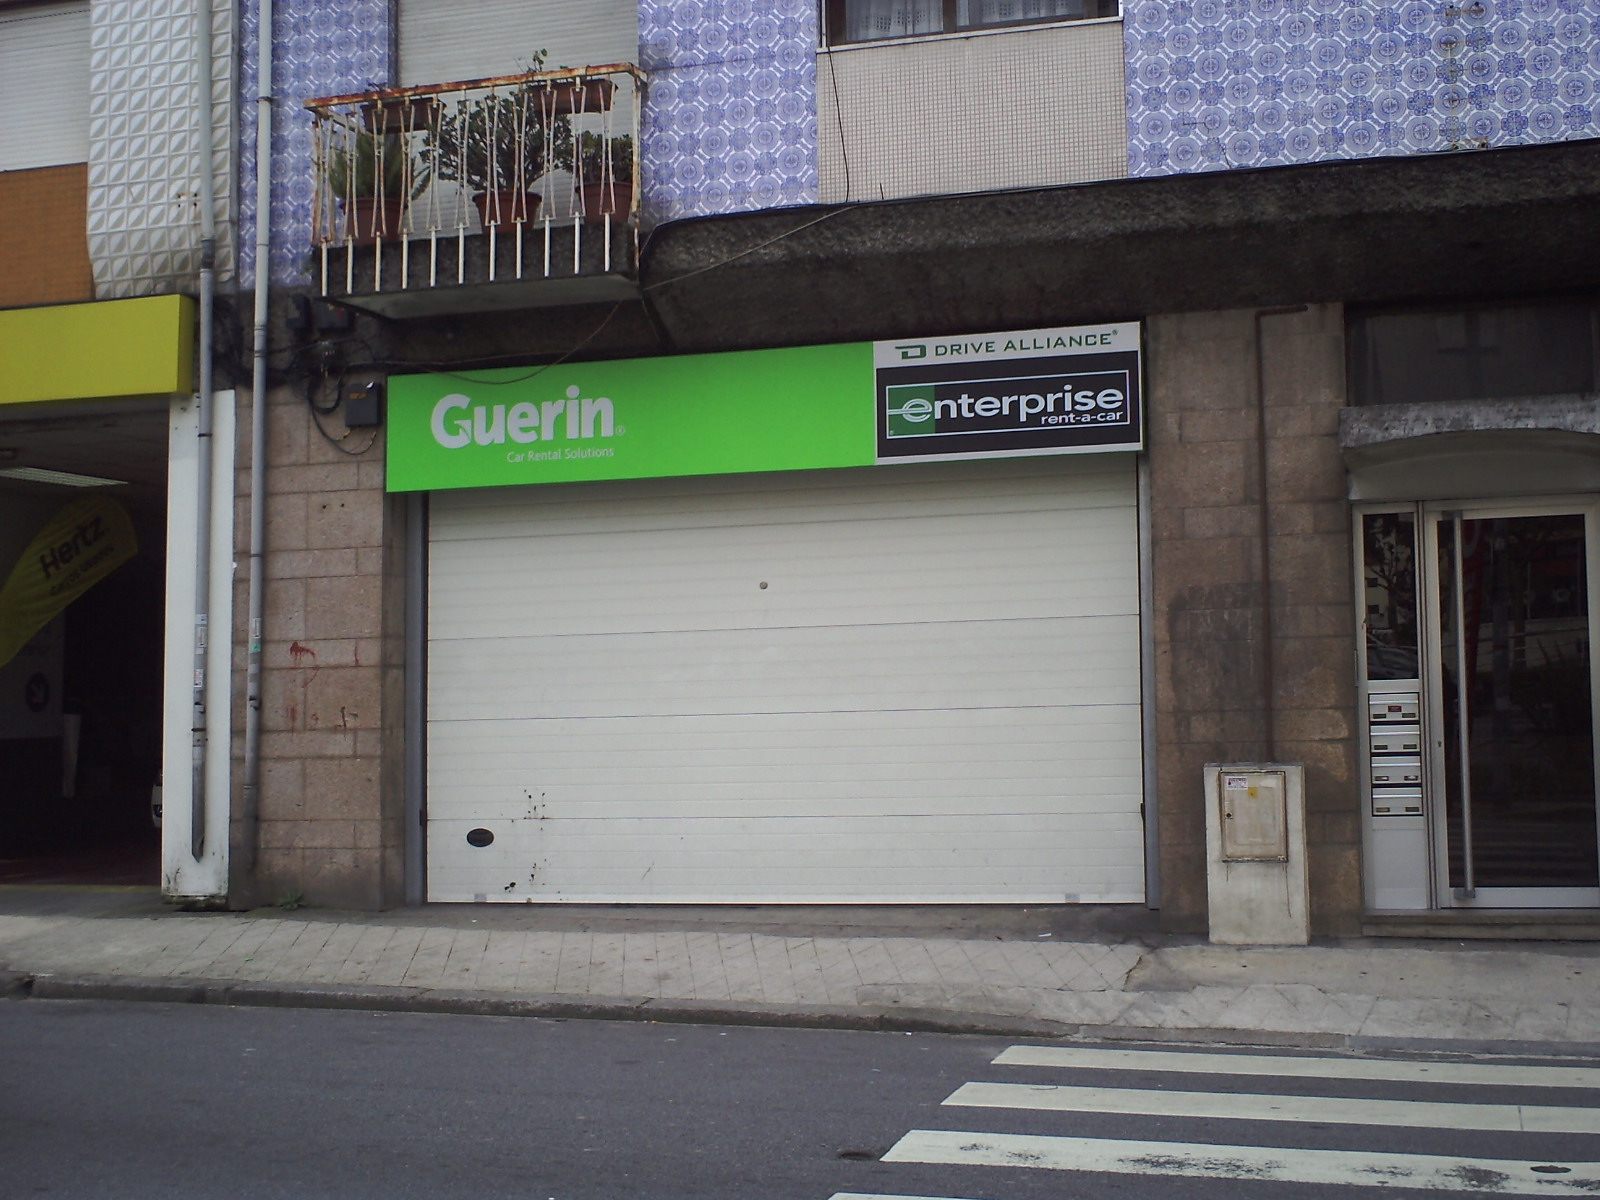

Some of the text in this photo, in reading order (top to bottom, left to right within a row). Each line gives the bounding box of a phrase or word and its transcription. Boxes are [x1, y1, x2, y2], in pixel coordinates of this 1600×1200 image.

[935, 341, 996, 357] DRIVE
[1004, 333, 1112, 351] ALLIANCE
[430, 384, 614, 449] Guerin
[888, 384, 1124, 423] enterprise
[1040, 410, 1123, 425] rent-a-car
[506, 447, 615, 463] Car Rental Solutions
[40, 516, 104, 579] Hertz
